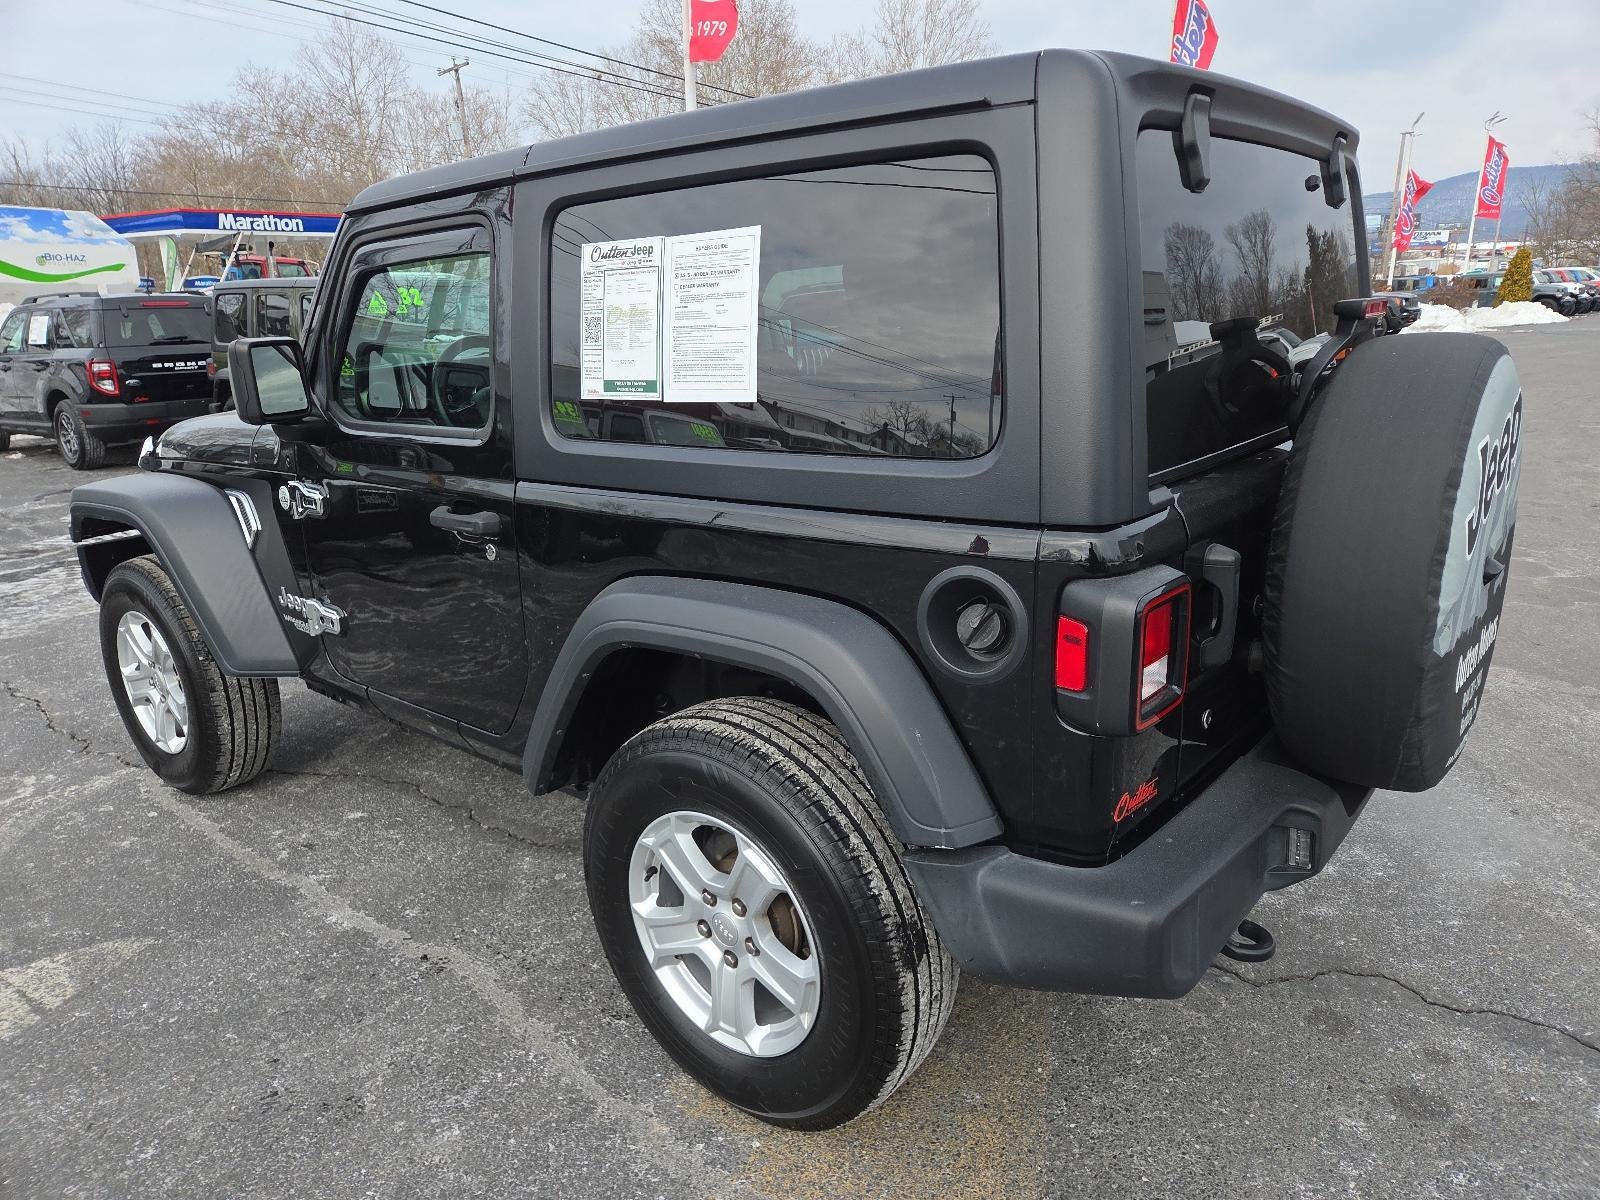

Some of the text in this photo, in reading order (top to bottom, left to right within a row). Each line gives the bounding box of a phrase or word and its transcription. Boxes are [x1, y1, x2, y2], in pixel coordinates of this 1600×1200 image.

[697, 20, 728, 37] 1979
[1481, 145, 1504, 205] Outten
[218, 213, 304, 232] Marathon
[44, 253, 86, 262] BIO-HAZ
[591, 246, 632, 262] Outten
[632, 244, 654, 257] Jeep
[152, 361, 207, 369] BRONC
[1466, 387, 1523, 560] Jeep
[278, 586, 308, 618] Jeep
[1113, 777, 1159, 822] Outten
